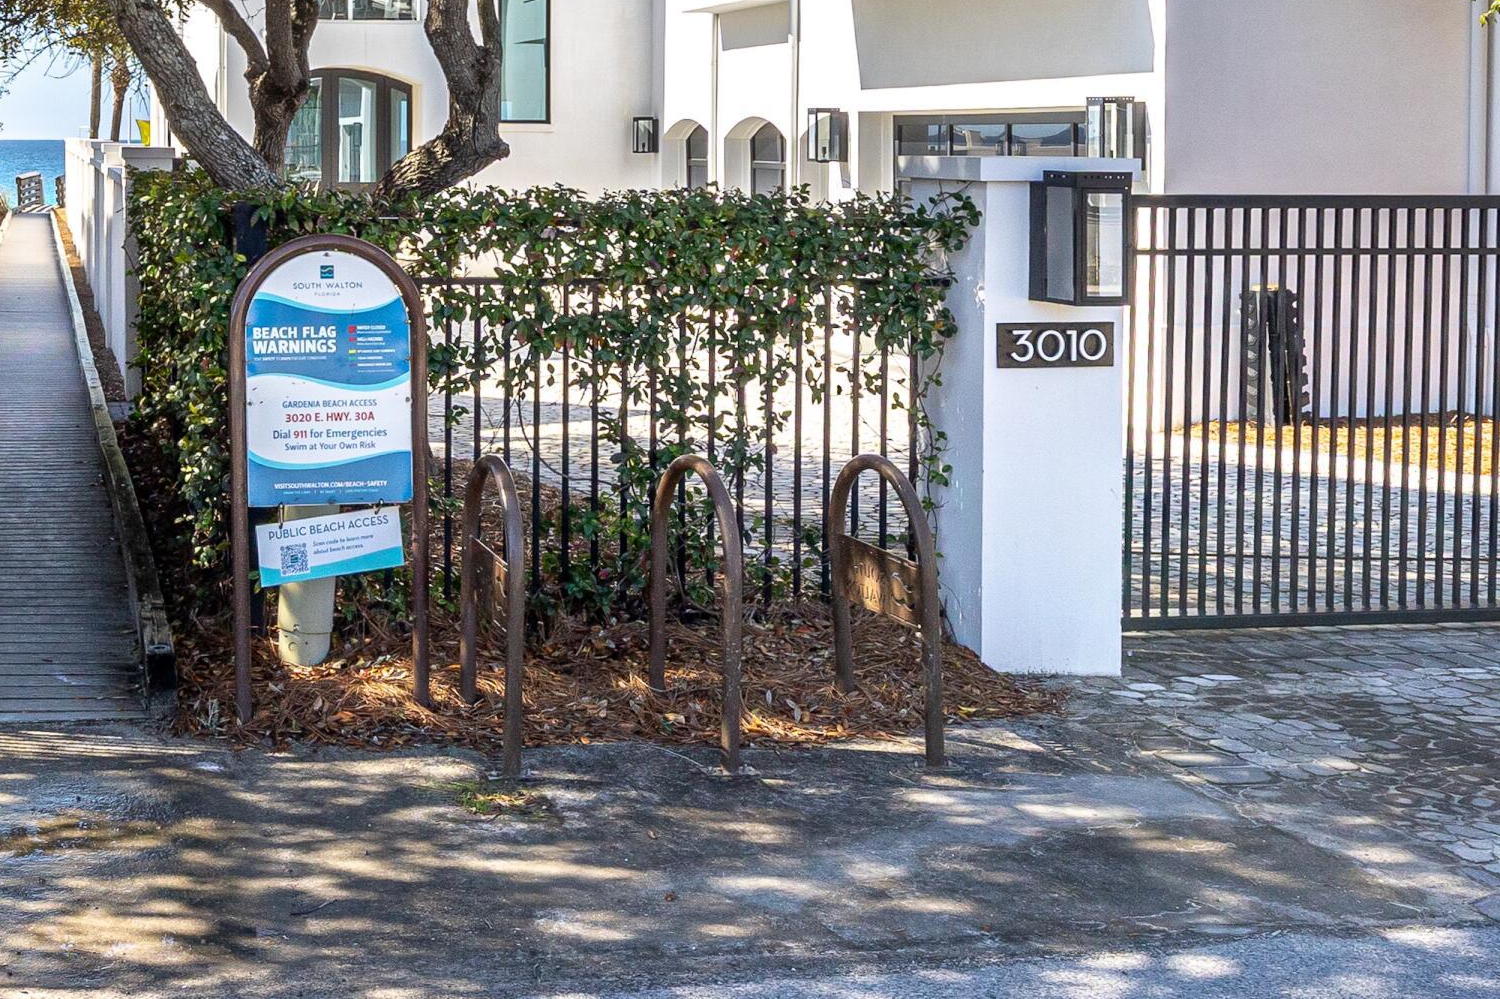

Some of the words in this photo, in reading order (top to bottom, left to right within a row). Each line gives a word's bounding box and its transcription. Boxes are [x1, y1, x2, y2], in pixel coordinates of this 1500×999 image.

[293, 282, 321, 290] SOUTH
[325, 281, 363, 289] WALTON
[252, 326, 299, 340] BEACH
[302, 326, 337, 339] FLAG
[253, 339, 337, 354] WARNINGS
[1010, 329, 1107, 362] 3010
[282, 400, 320, 408] GARDENIA
[322, 399, 348, 407] BEACH
[349, 399, 377, 407] ACCESS
[285, 413, 311, 423] 3020
[314, 413, 323, 422] E.
[326, 412, 352, 422] HWY.
[355, 412, 375, 421] 30A
[273, 430, 291, 439] Dial
[293, 430, 307, 439] 911
[309, 429, 323, 438] for
[326, 427, 387, 440] Emergencies
[284, 442, 307, 451] Swim
[319, 442, 337, 450] Your
[339, 442, 358, 450] Own
[359, 441, 376, 449] Risk
[274, 480, 388, 489] VISITSOUTHWALTON.COM/BEACH-SAFETY
[268, 525, 307, 541] PUBLIC
[309, 520, 345, 536] BEACH
[348, 515, 389, 529] ACCESS
